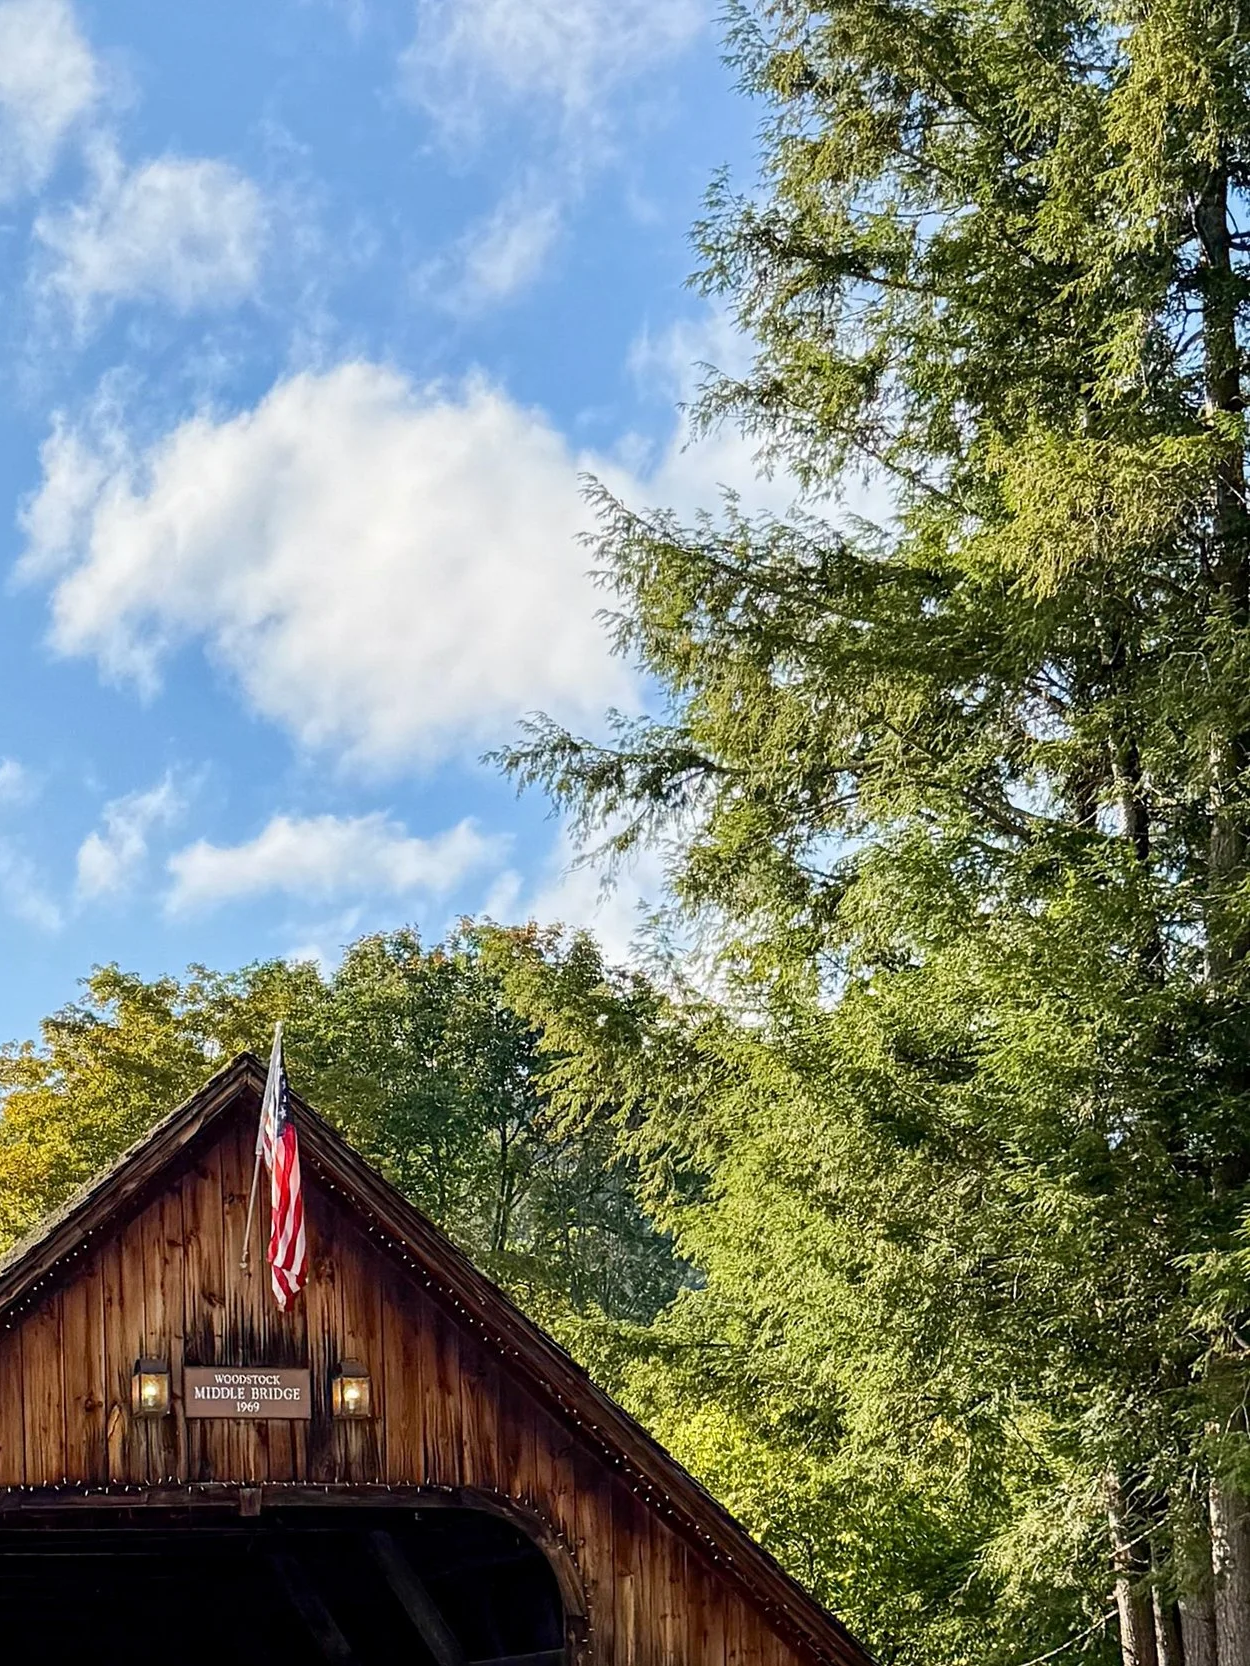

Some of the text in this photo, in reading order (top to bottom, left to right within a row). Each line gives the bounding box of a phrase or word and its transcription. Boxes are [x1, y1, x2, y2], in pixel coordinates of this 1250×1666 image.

[214, 1374, 281, 1385] WOODSTOCK
[194, 1387, 301, 1400] MIDDLE BRIDGE
[236, 1402, 260, 1413] 1969
